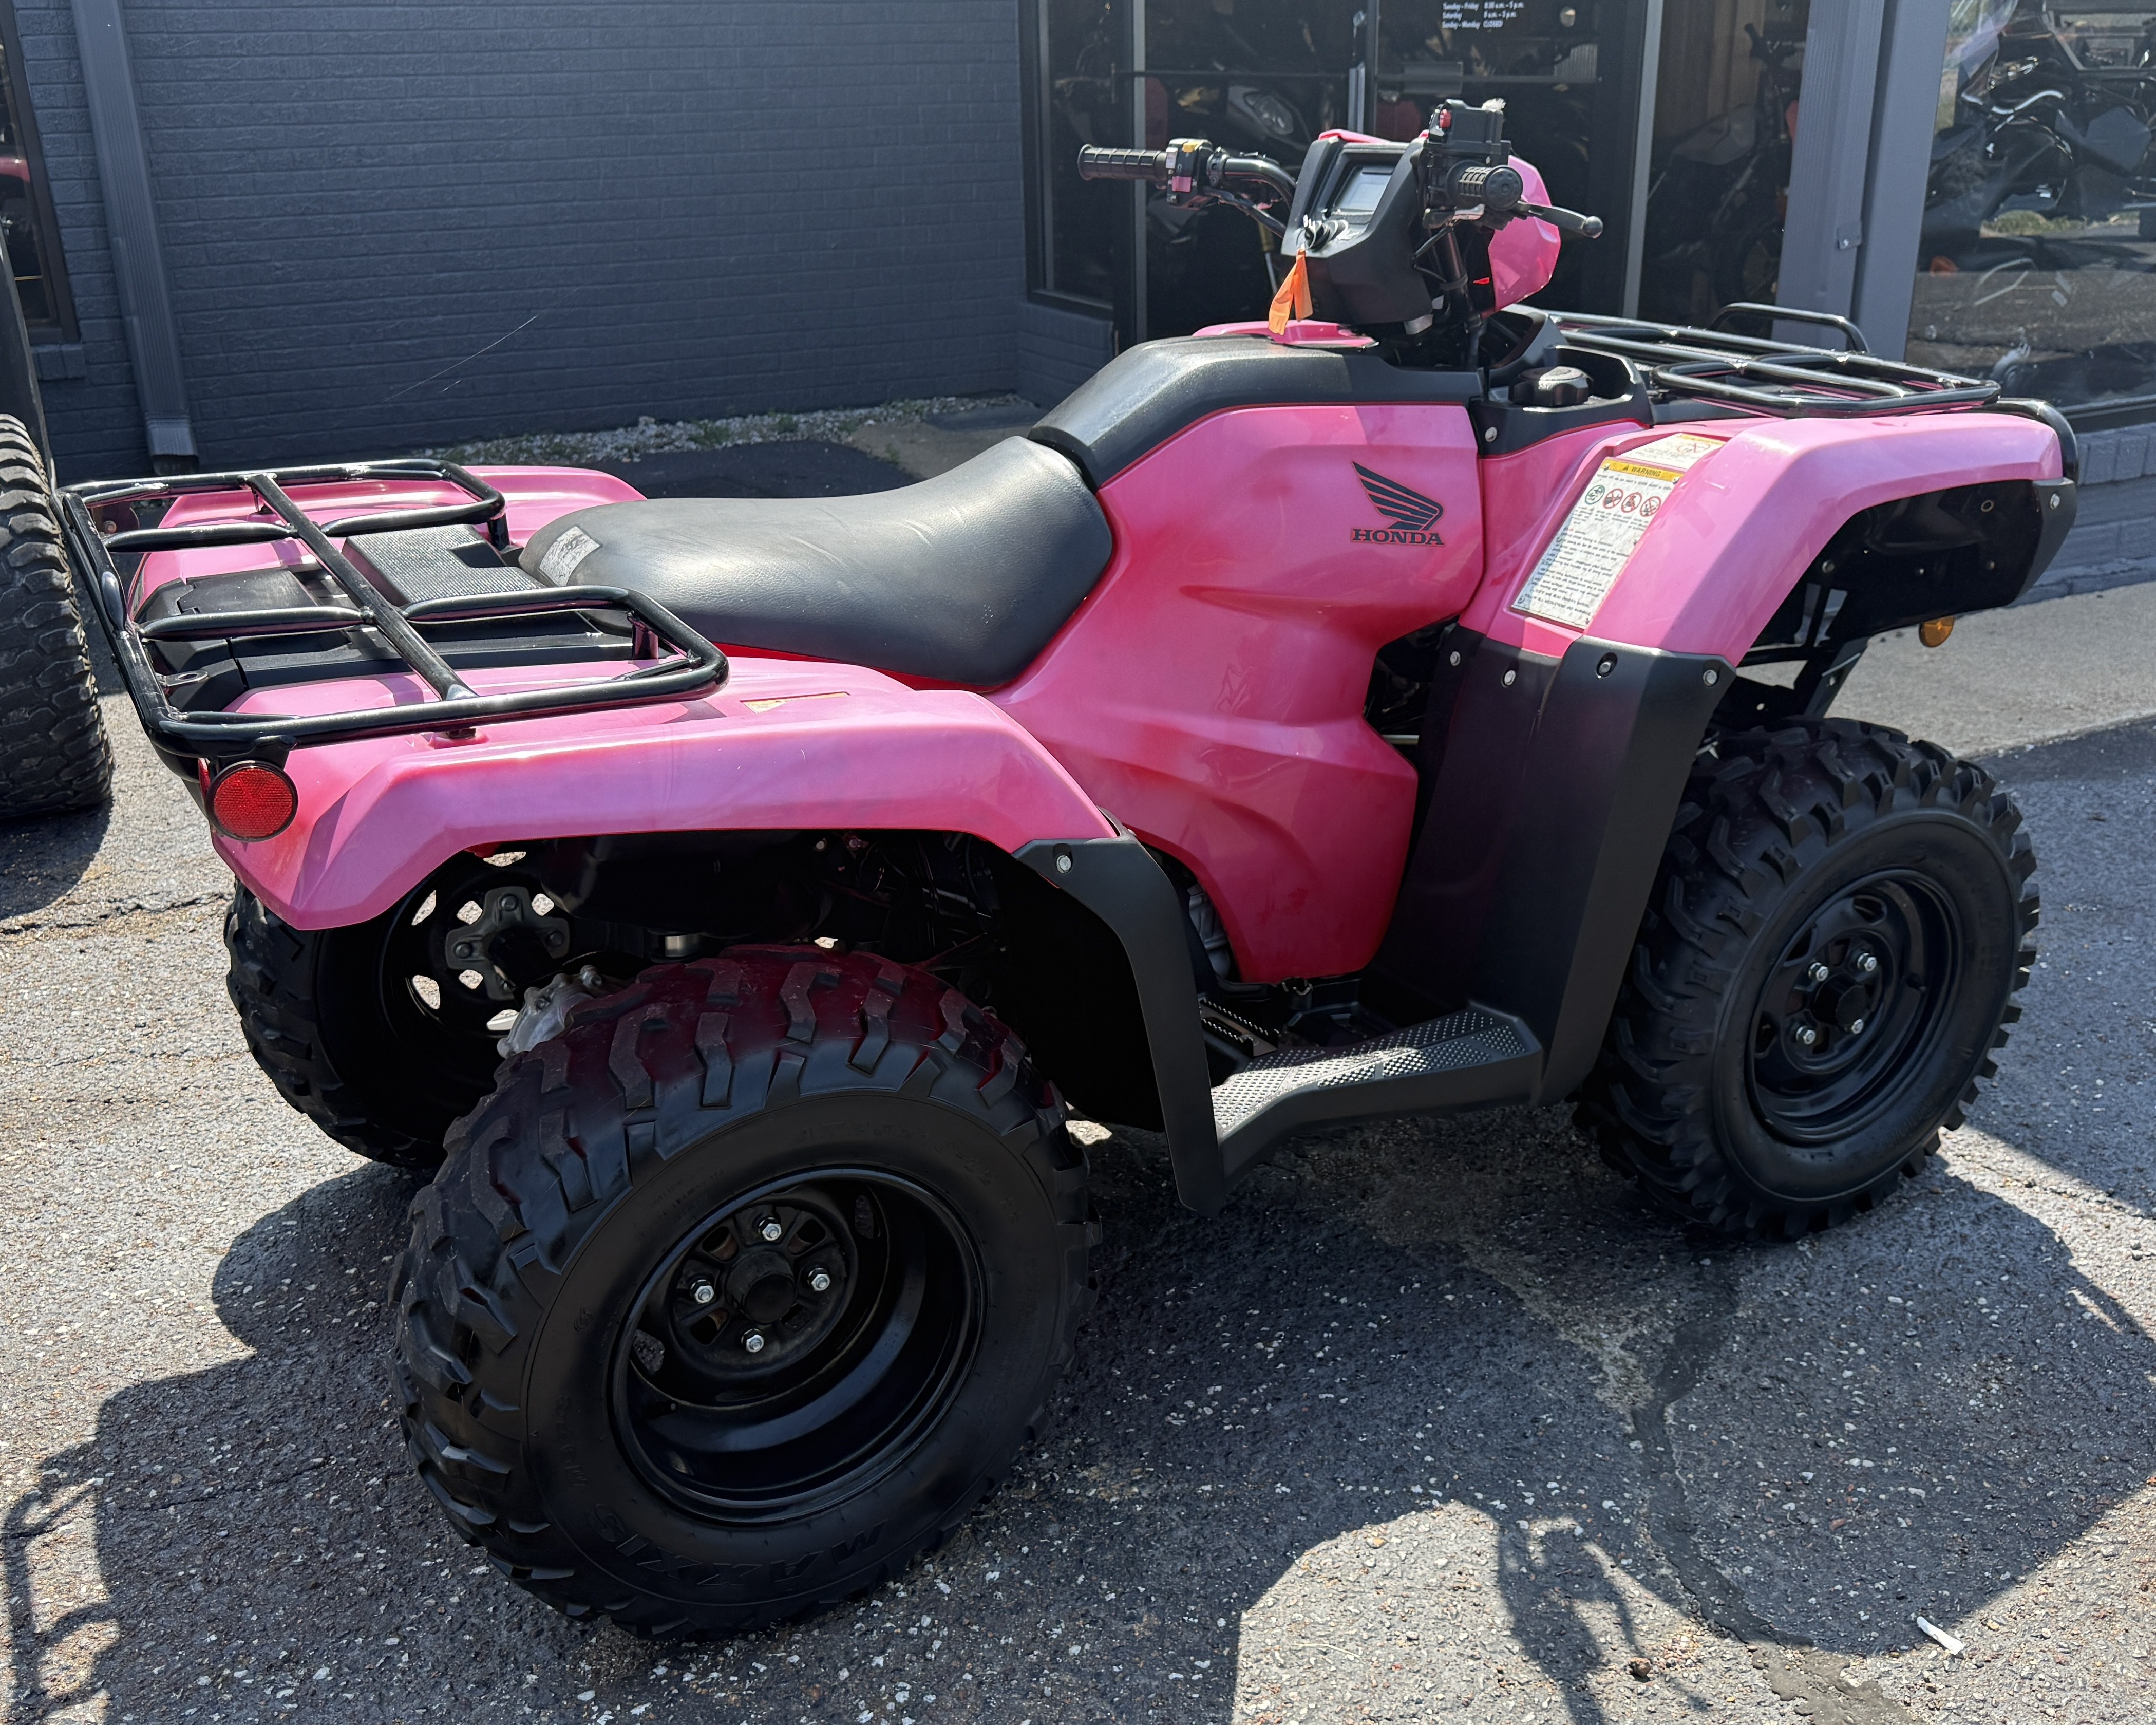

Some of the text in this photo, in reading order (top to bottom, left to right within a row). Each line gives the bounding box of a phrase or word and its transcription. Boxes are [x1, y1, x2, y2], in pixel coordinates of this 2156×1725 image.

[1631, 466, 1661, 477] WARNING
[1352, 529, 1444, 545] HONDA
[587, 1503, 889, 1586] MAXXIS
